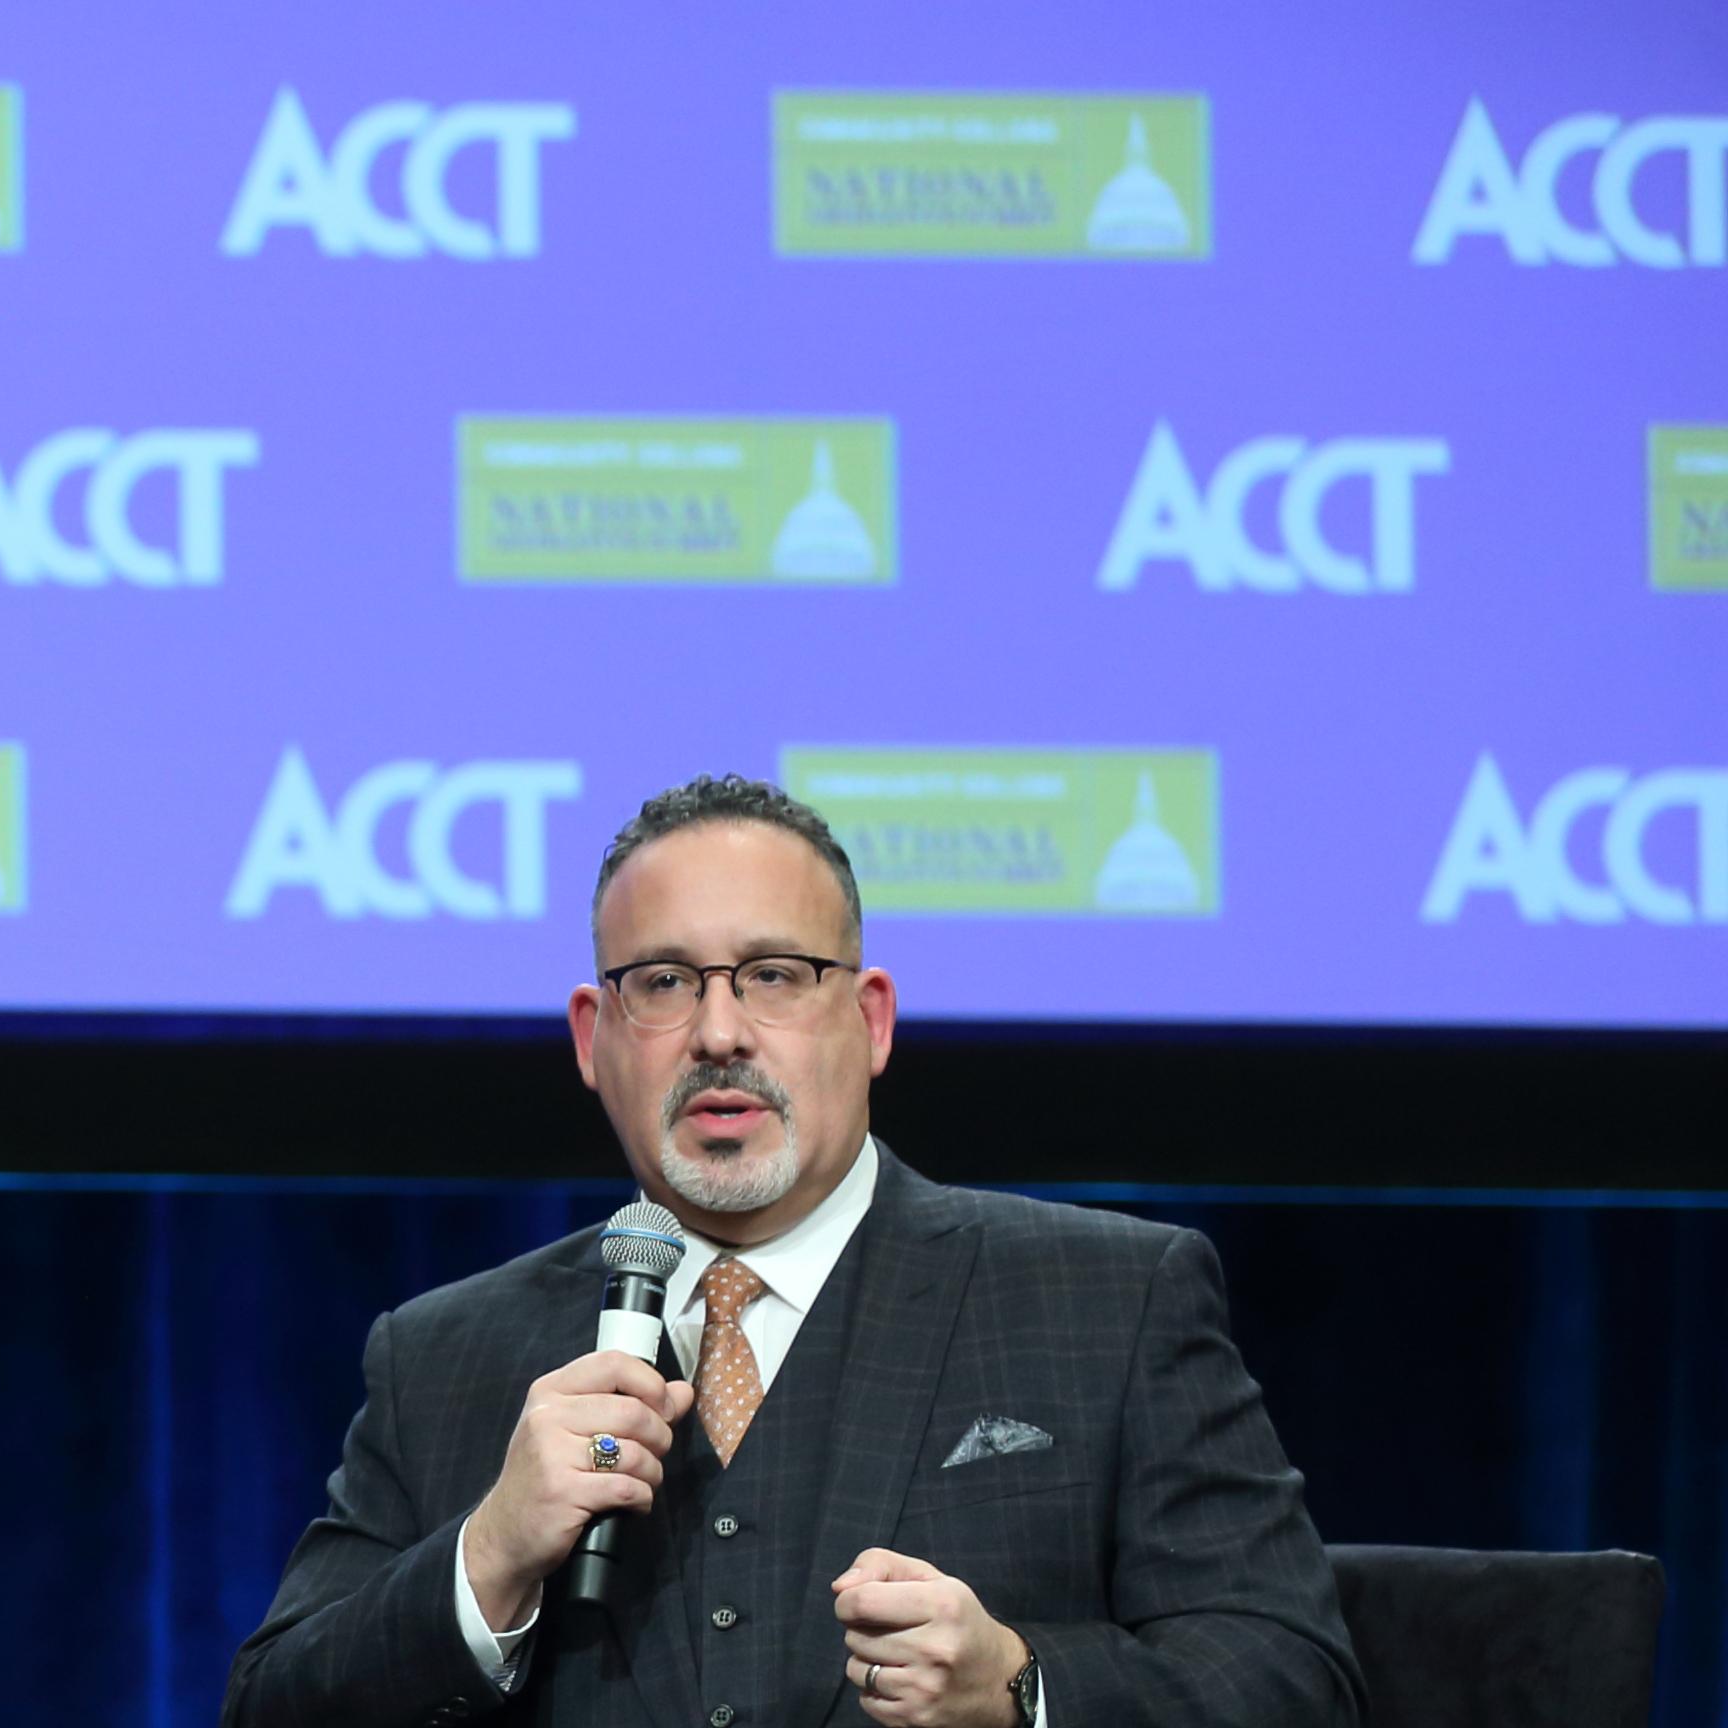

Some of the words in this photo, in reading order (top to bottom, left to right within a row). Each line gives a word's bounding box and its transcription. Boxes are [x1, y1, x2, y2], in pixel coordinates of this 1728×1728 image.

[222, 87, 575, 258] ACCT
[1098, 421, 1450, 593] ACCT
[226, 745, 581, 919] ACCT
[853, 825, 1059, 858] ATIONAL
